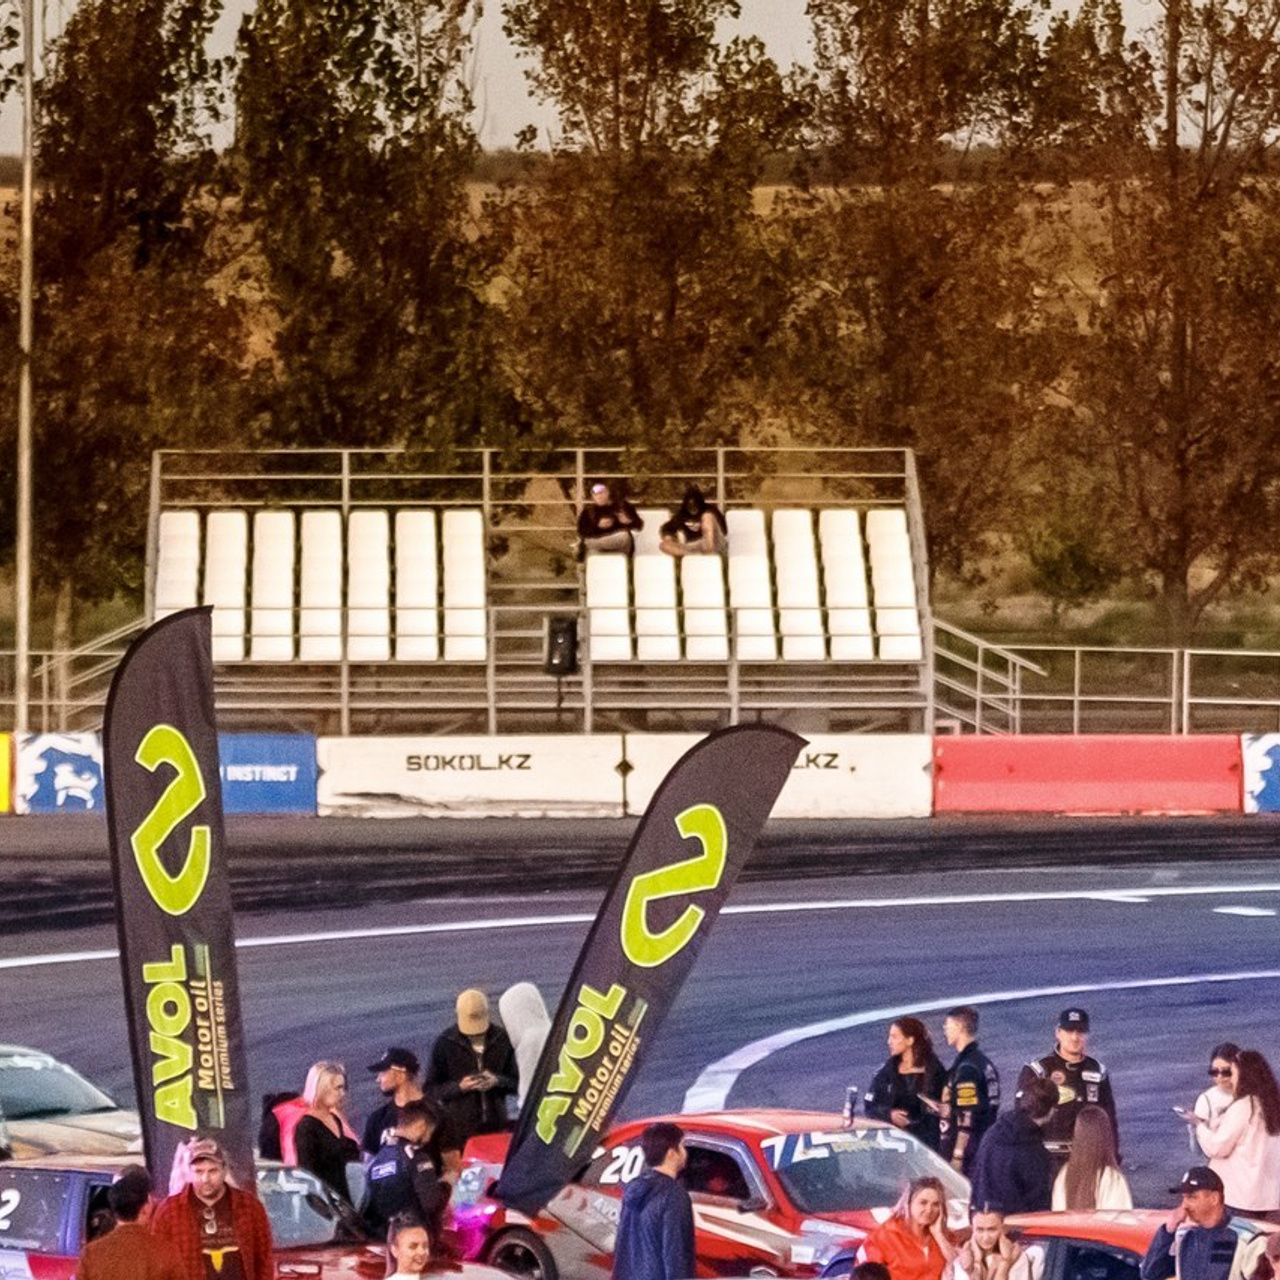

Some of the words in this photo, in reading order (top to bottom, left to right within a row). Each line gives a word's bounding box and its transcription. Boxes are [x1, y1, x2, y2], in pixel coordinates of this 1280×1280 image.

[227, 765, 297, 781] INSTINCT
[190, 980, 209, 1013] oil
[213, 980, 226, 1022] series
[143, 944, 197, 1130] AVOL
[195, 1016, 216, 1090] Motor
[216, 1023, 235, 1090] premium
[535, 984, 627, 1144] AVOL
[573, 1055, 614, 1123] Motor
[608, 1022, 631, 1058] oil
[591, 1072, 624, 1132] premium
[620, 1036, 642, 1075] series
[592, 1146, 645, 1184] 20
